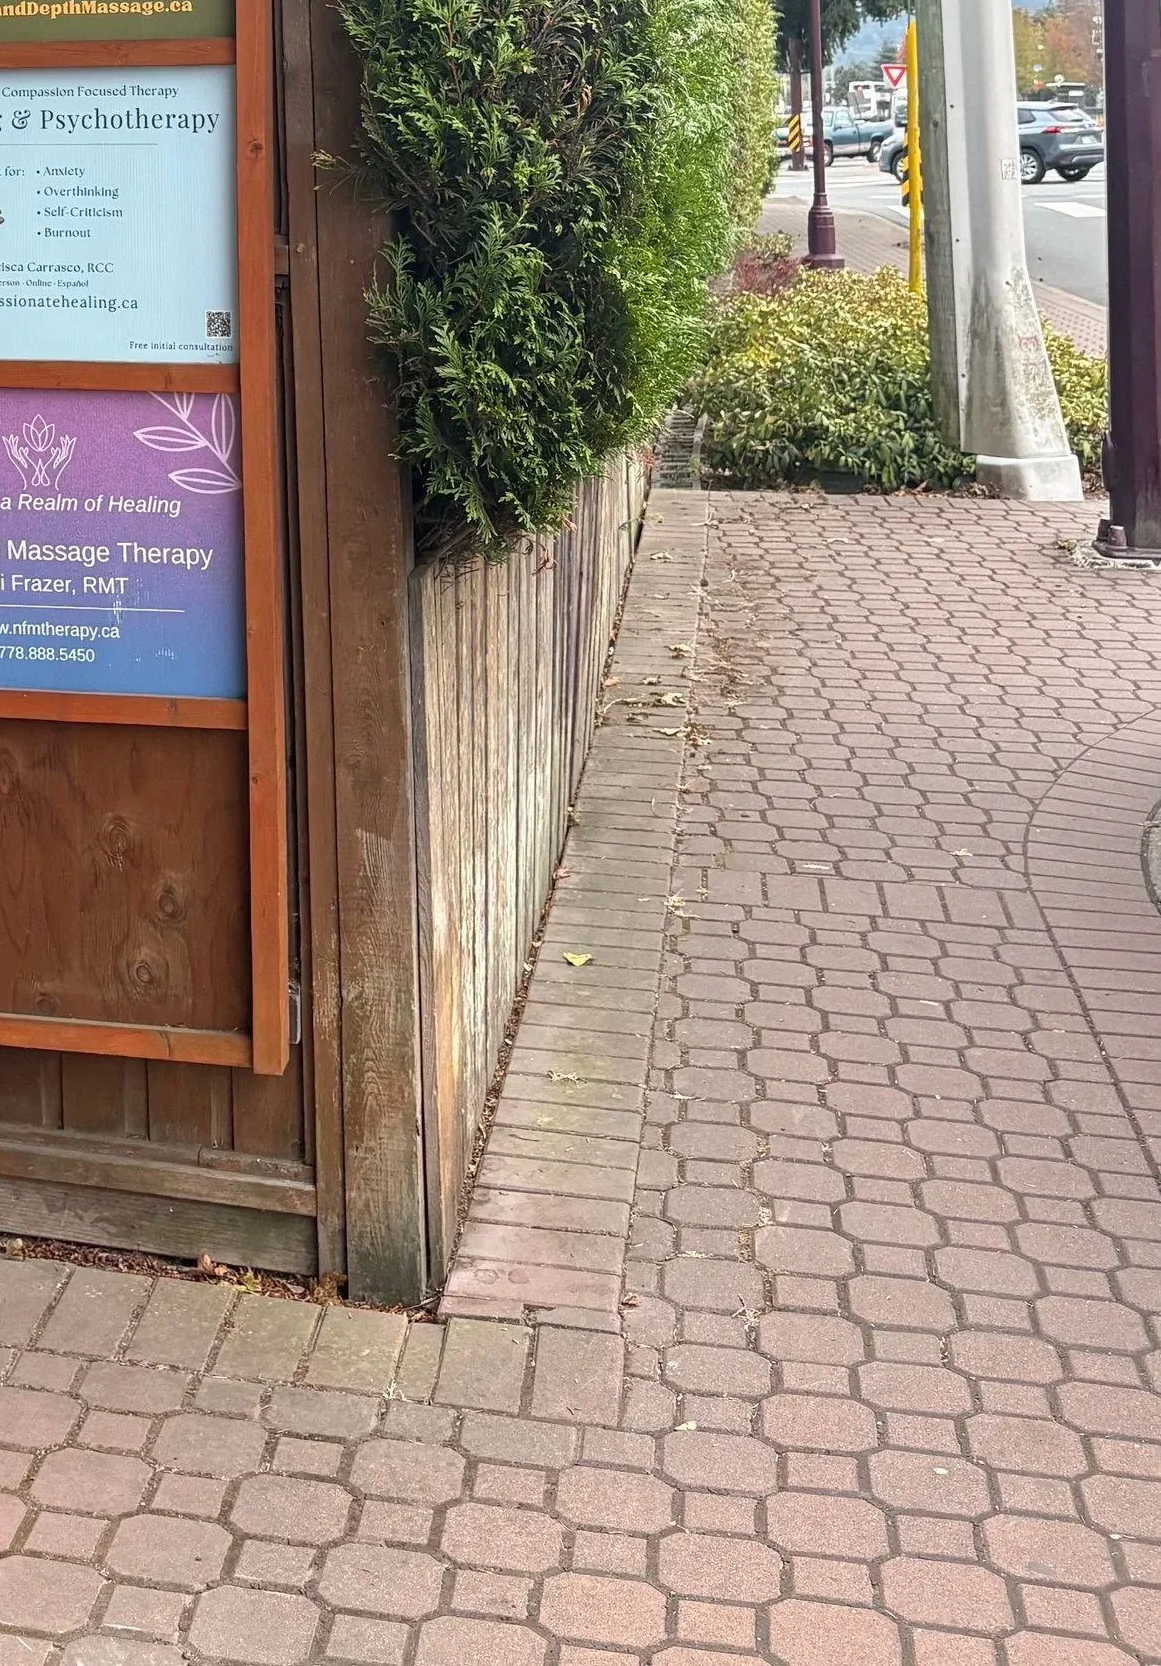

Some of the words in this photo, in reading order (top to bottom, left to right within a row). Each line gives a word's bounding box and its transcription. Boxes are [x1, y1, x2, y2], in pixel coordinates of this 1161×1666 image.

[1, 86, 74, 99] Compassion
[78, 86, 126, 97] Focused
[129, 85, 179, 99] Therapy
[12, 110, 32, 129] &
[40, 108, 220, 133] Psychotherapy
[5, 165, 25, 177] for:
[43, 165, 85, 178] Anxiety
[44, 186, 119, 199] Overthinking
[44, 206, 123, 218] Self-Criticism
[44, 227, 91, 238] Burnout
[27, 262, 84, 275] Carrasco,
[87, 262, 114, 273] RCC
[26, 279, 52, 287] Online
[58, 279, 89, 289] Español
[129, 341, 150, 350] Free
[153, 342, 176, 351] initial
[179, 343, 233, 352] consultation
[0, 498, 12, 510] a
[18, 494, 78, 511] Realm
[85, 495, 103, 512] of
[108, 496, 181, 517] Healing
[8, 540, 110, 567] Massage
[116, 542, 213, 569] Therapy
[12, 576, 76, 594] Frazer,
[83, 578, 128, 593] RMT
